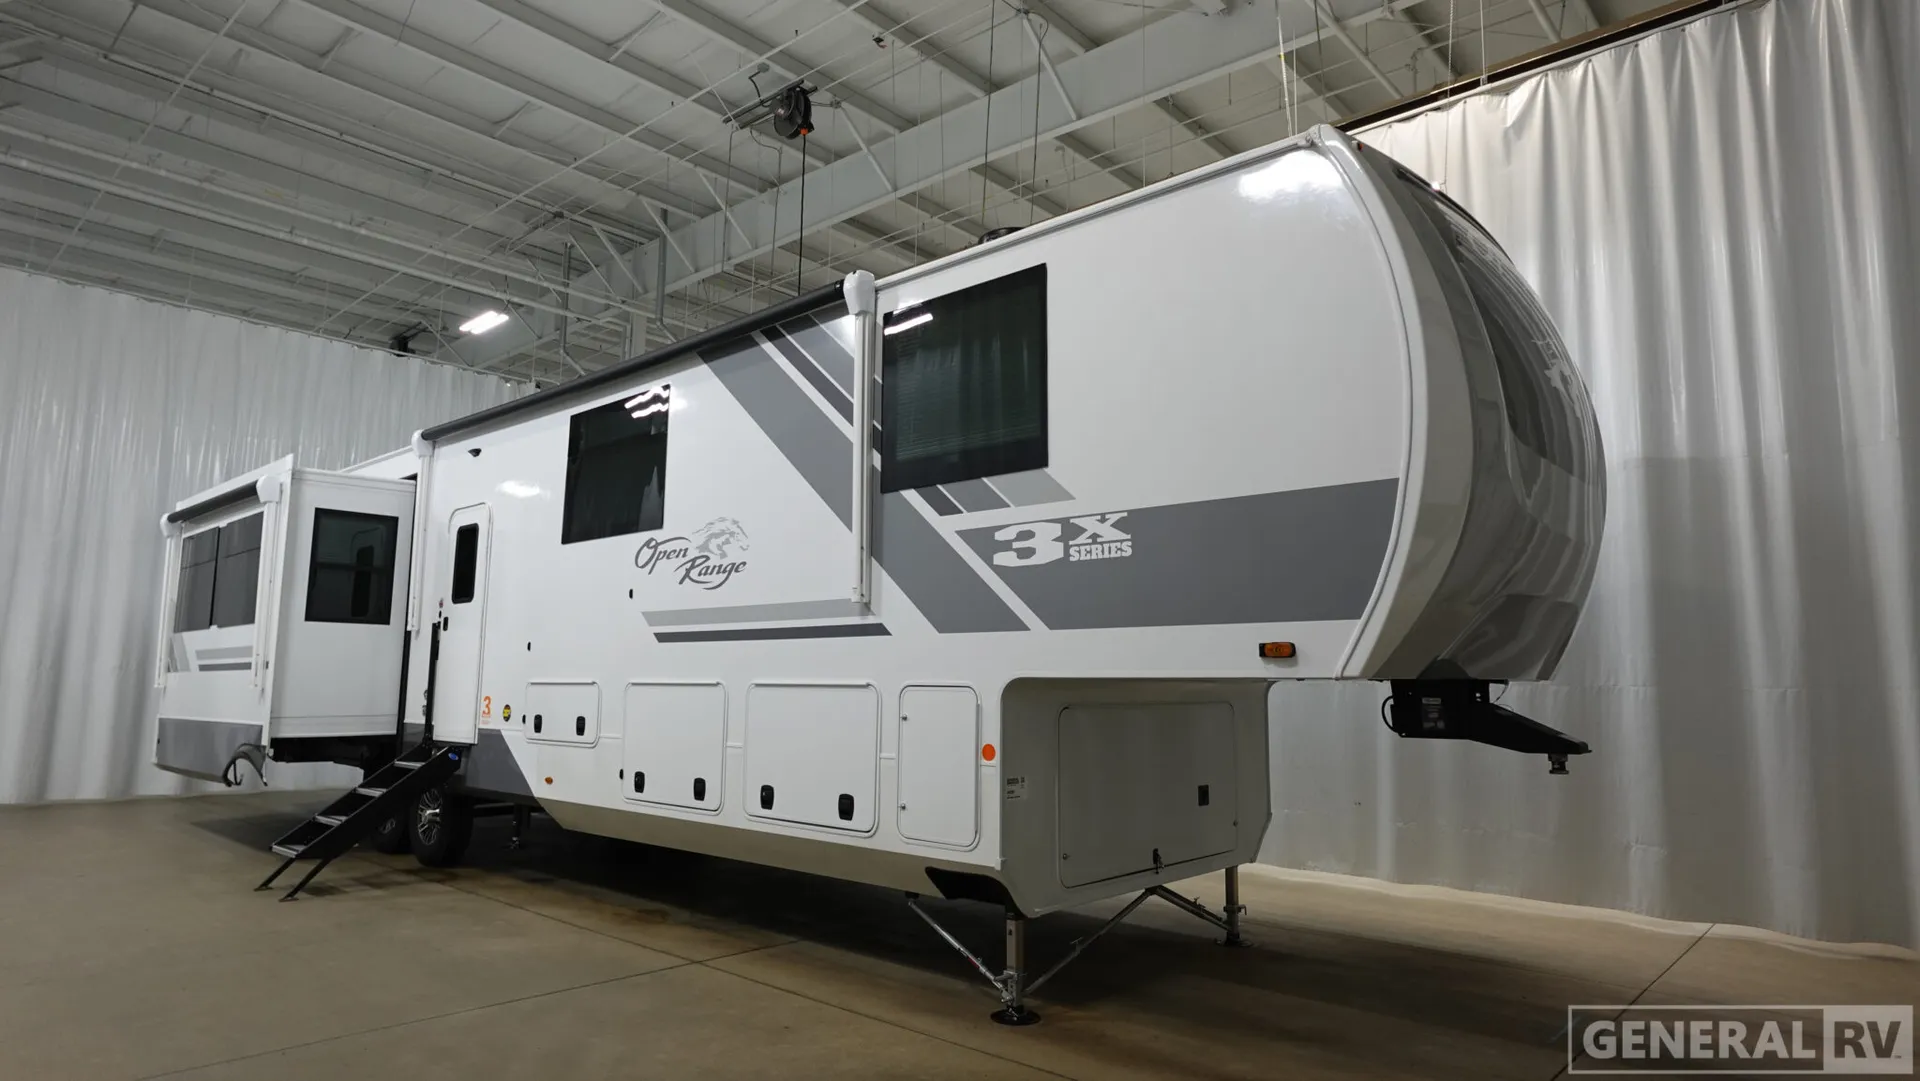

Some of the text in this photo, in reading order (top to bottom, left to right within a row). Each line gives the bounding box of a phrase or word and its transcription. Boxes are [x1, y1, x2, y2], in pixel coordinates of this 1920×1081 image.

[634, 536, 692, 576] Open
[993, 511, 1132, 567] 3 X
[1069, 541, 1133, 562] SERIES
[673, 554, 748, 590] Range
[482, 695, 492, 715] 3
